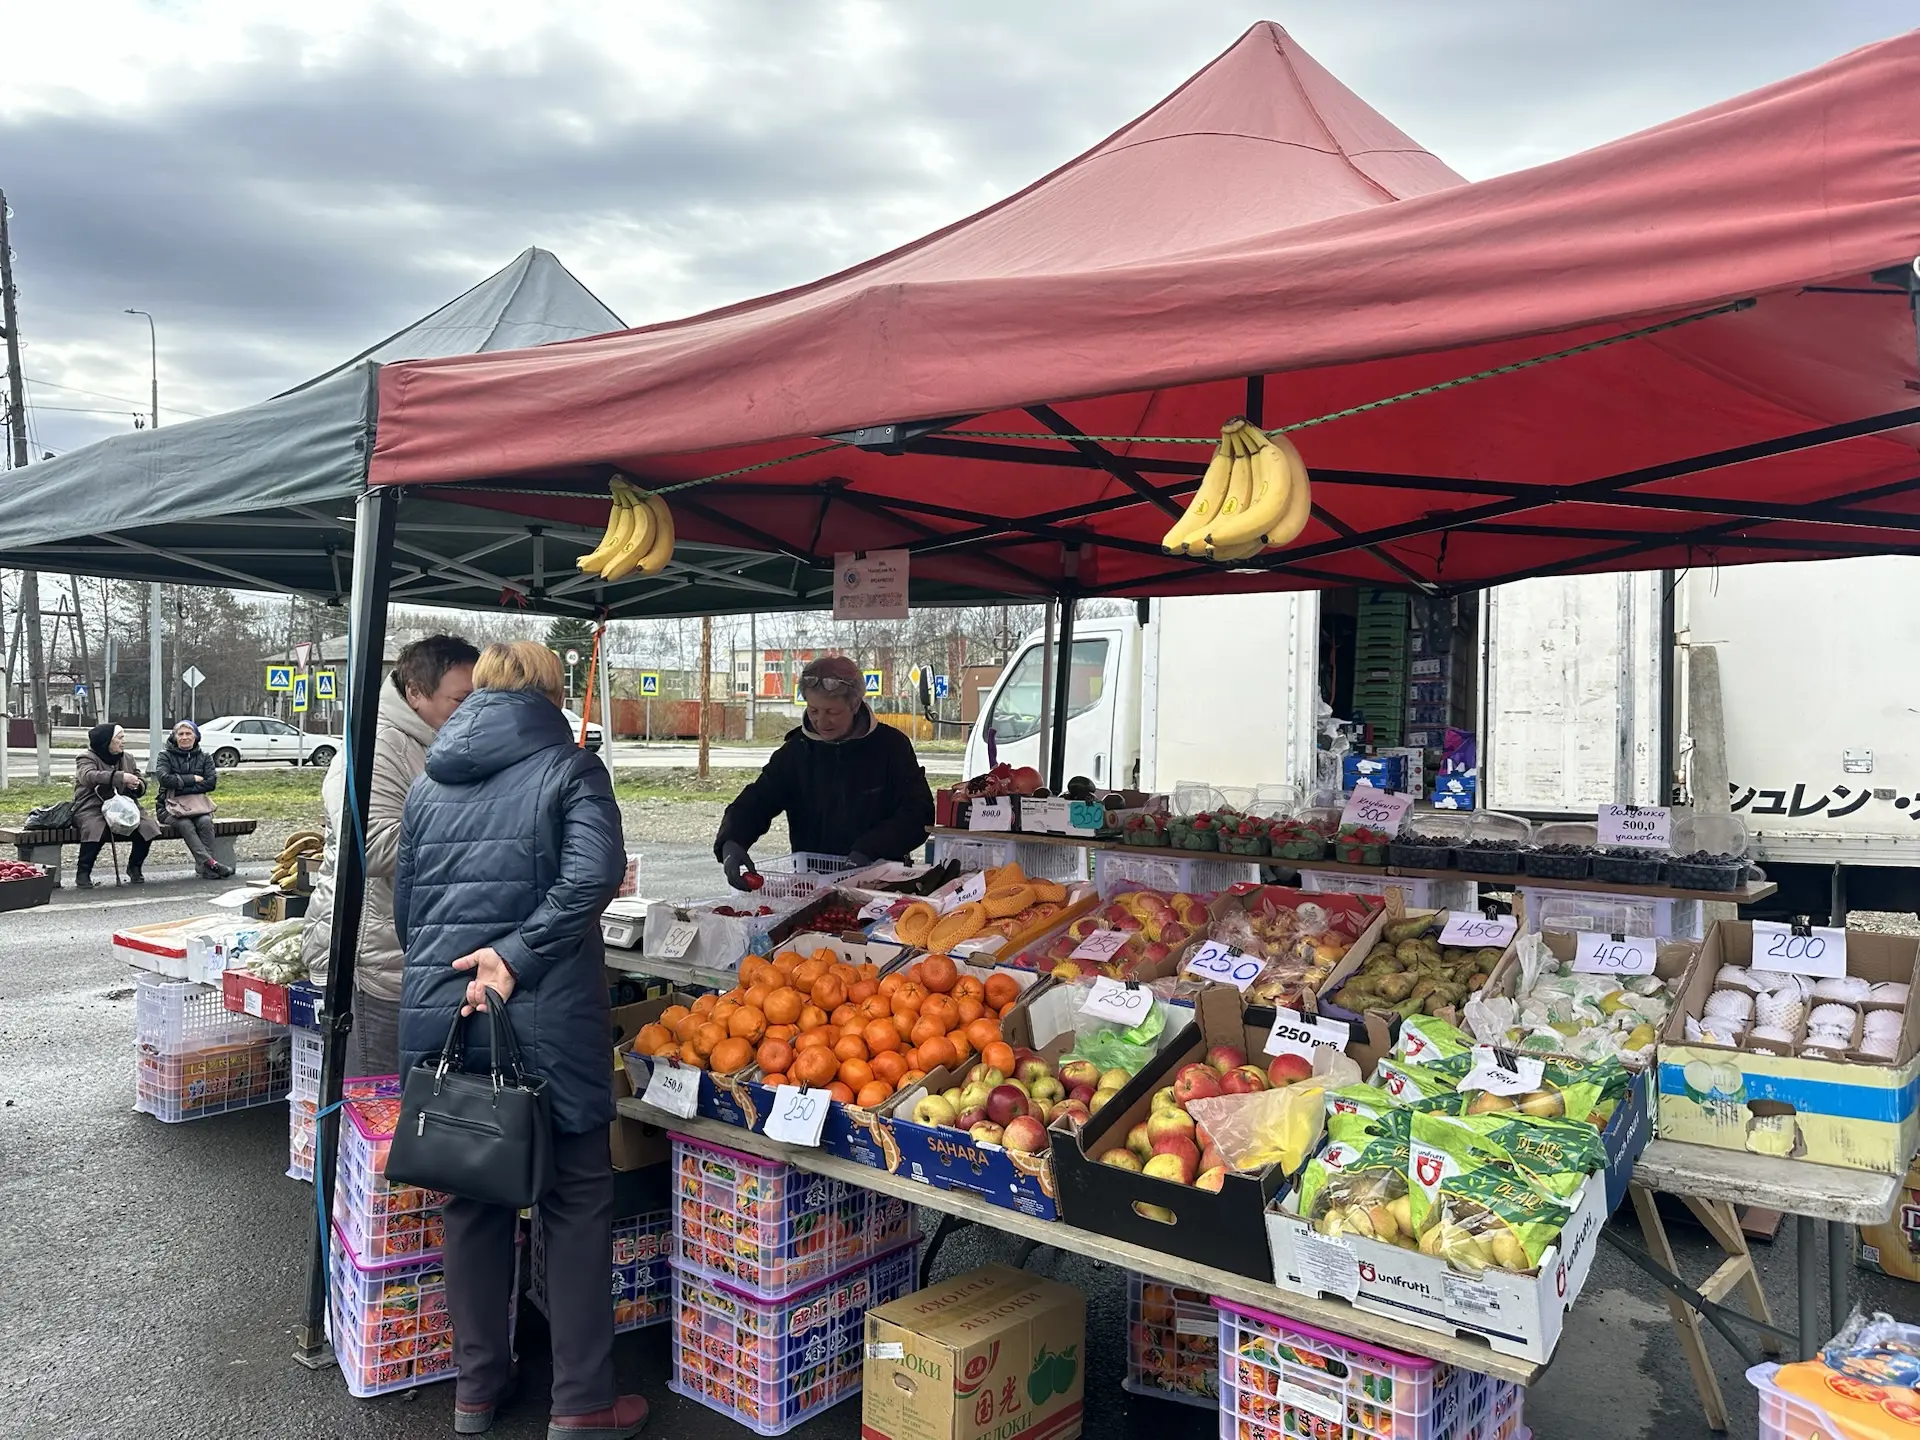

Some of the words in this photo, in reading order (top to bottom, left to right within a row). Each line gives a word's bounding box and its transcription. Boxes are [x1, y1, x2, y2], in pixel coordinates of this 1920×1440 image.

[1357, 806, 1390, 822] 500
[1622, 820, 1655, 832] 500,0
[665, 928, 694, 947] 500
[1456, 919, 1504, 939] 450
[1592, 943, 1644, 971] 450
[1767, 933, 1826, 960] 200
[1192, 948, 1259, 981] 250
[1098, 988, 1142, 1009] 250
[1275, 1025, 1311, 1044] 250
[663, 1075, 683, 1093] 250,0
[783, 1095, 816, 1121] 250
[927, 1136, 990, 1167] SAHARA
[1377, 1272, 1431, 1295] unifrutti
[959, 1291, 1042, 1331] ЯБЛОКИ
